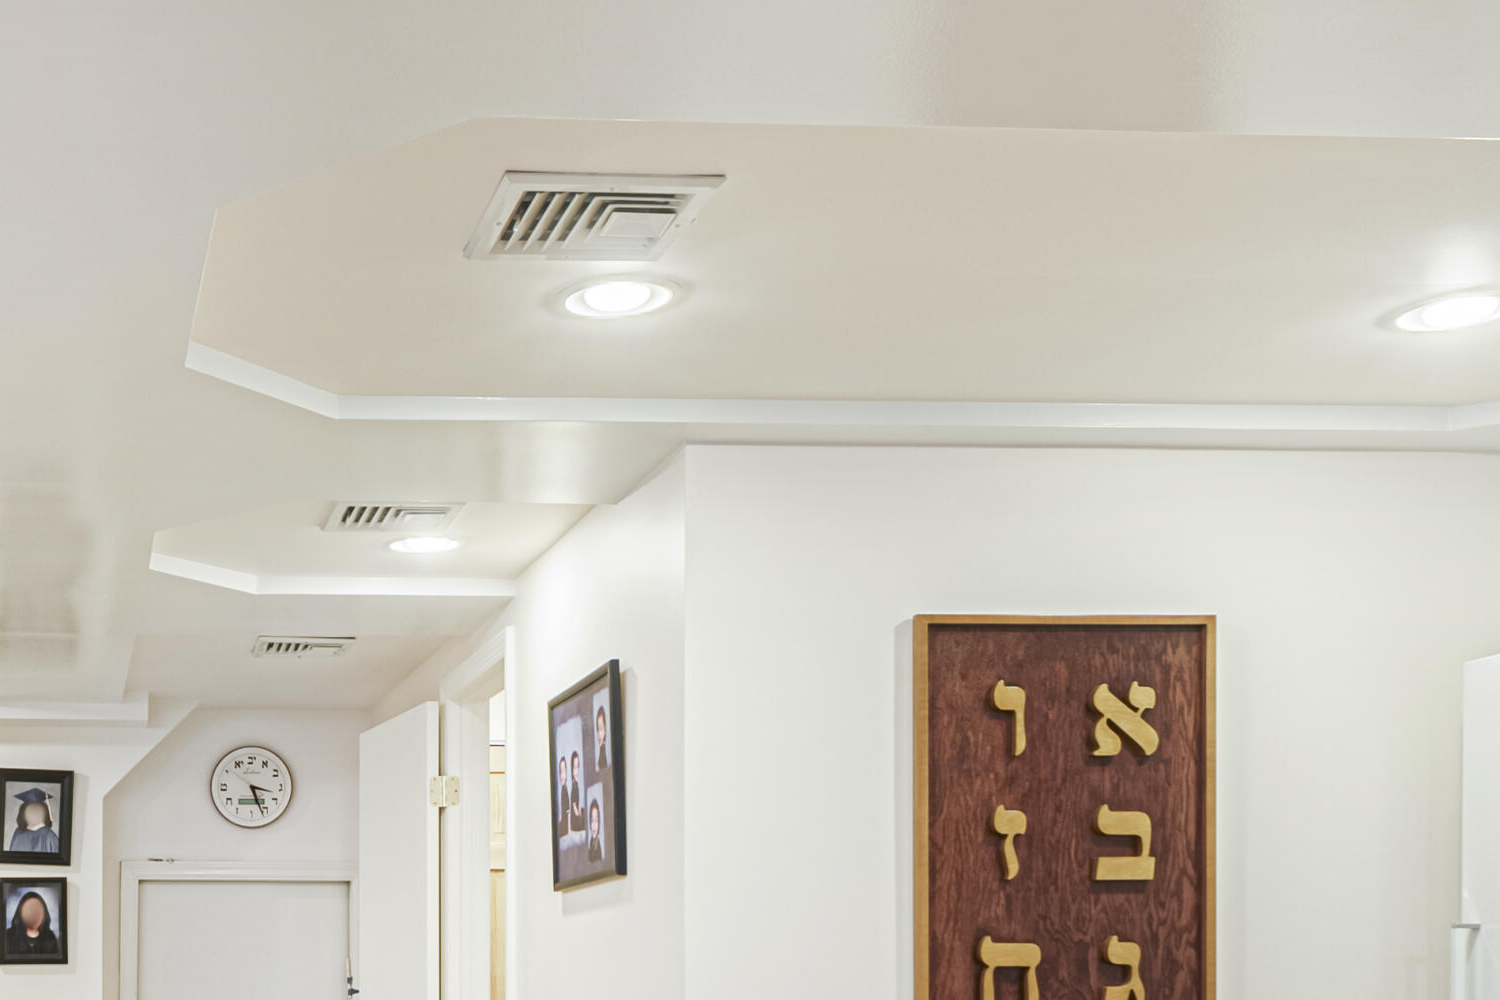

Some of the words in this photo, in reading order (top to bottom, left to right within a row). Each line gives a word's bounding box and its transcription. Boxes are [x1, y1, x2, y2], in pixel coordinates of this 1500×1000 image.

[993, 679, 1027, 756] ו
[1092, 681, 1160, 756] א
[261, 760, 269, 769] א
[994, 804, 1027, 880] ז
[1095, 804, 1156, 881] ב
